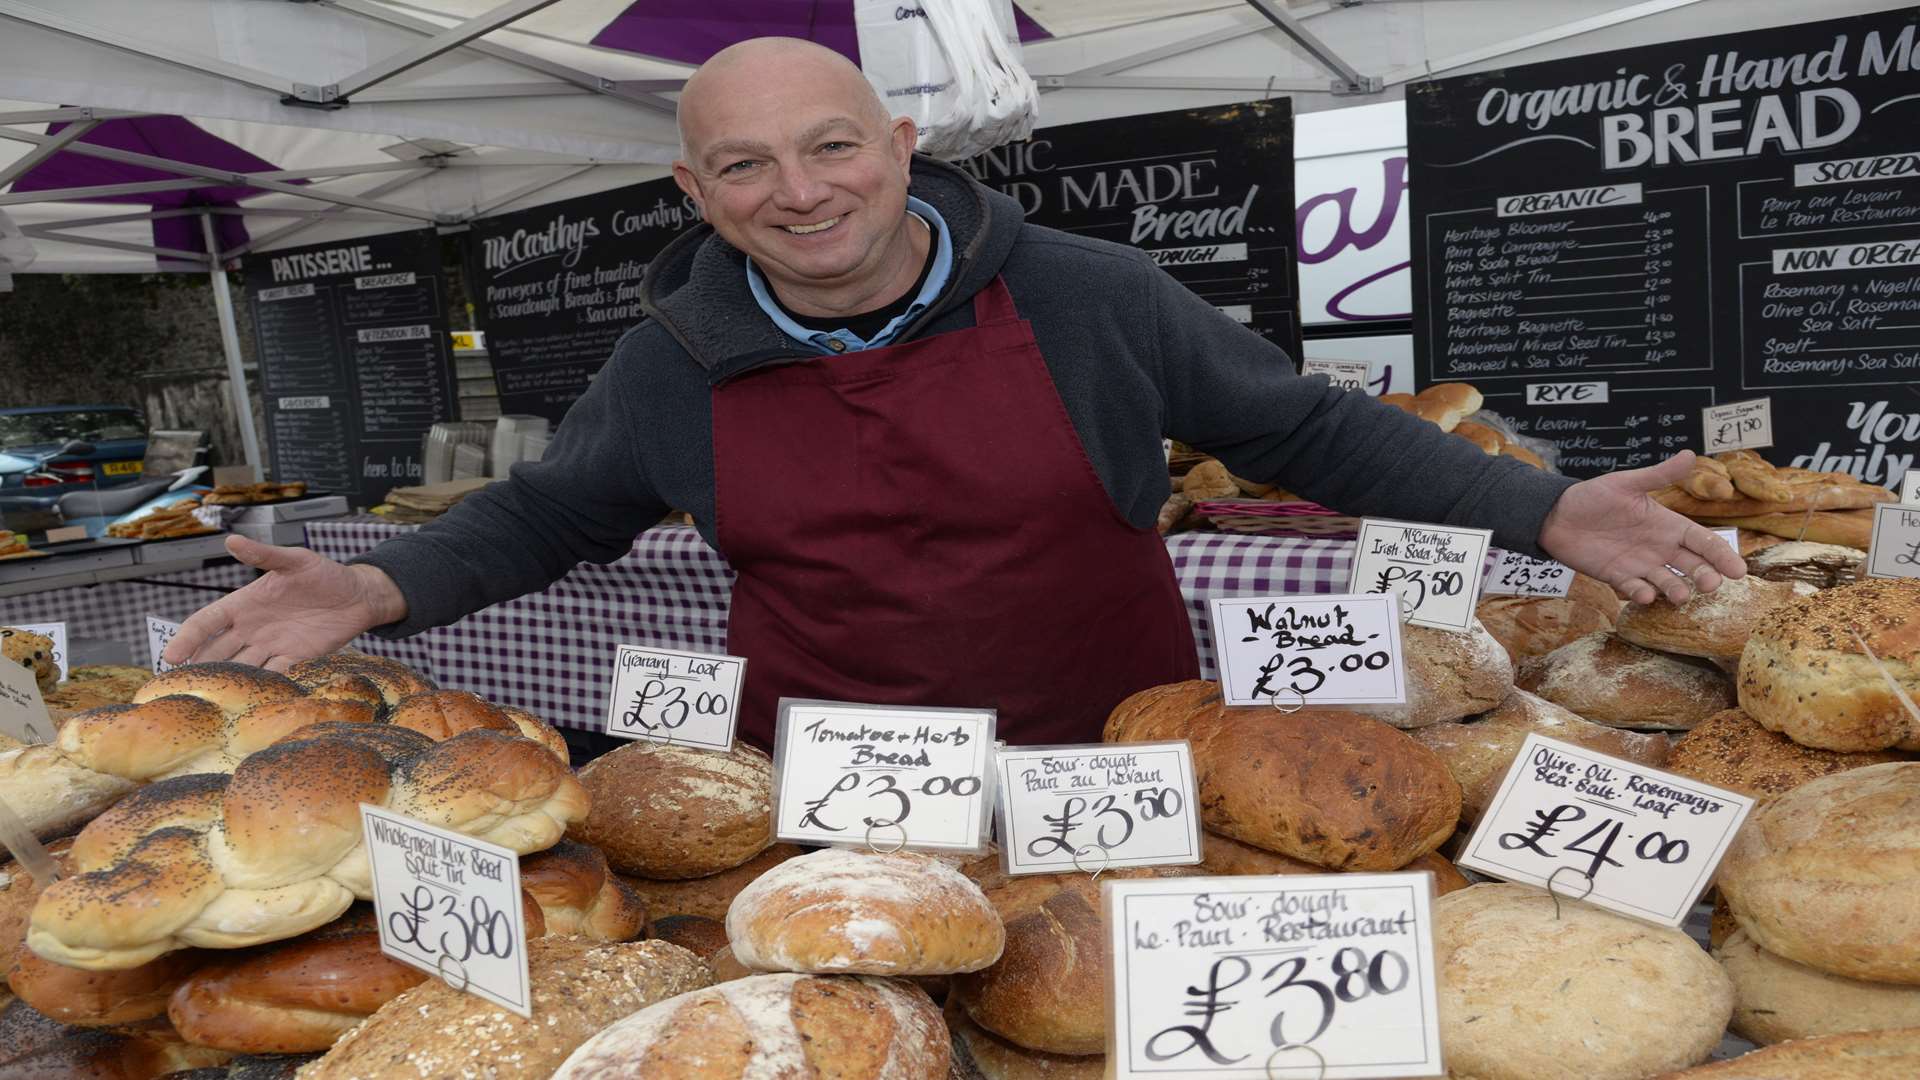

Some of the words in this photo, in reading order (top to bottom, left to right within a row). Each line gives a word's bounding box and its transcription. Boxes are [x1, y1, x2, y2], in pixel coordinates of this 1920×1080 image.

[1476, 68, 1652, 130] Organic
[1655, 63, 1688, 105] &
[1697, 36, 1847, 97] Hand
[1602, 86, 1861, 170] BREAD
[1060, 159, 1219, 212] MADE
[1504, 187, 1628, 214] ORGANIC
[1762, 197, 1801, 213] Pain
[1808, 194, 1837, 209] au
[1843, 188, 1902, 205] Levain
[612, 198, 683, 236] Country
[1760, 215, 1778, 229] Le
[1785, 212, 1826, 227] Pain
[1444, 224, 1501, 244] Heritage
[1507, 220, 1575, 237] Bloomer
[1444, 245, 1473, 260] Pain
[1477, 243, 1495, 257] de
[1502, 238, 1579, 257] Campagne
[1782, 248, 1839, 271] NON
[1444, 260, 1473, 274] Irish
[1479, 257, 1509, 271] Soda
[1516, 254, 1559, 267] Bread
[546, 272, 562, 298] of
[563, 272, 592, 293] fine
[1445, 276, 1482, 289] White
[1488, 270, 1523, 288] Split
[1527, 267, 1552, 284] Tin
[1763, 282, 1844, 299] Rosemary
[496, 297, 560, 318] Sourdough
[565, 288, 605, 308] Breads
[1447, 305, 1516, 323] Baguette
[1762, 303, 1804, 319] Olive
[1447, 323, 1511, 340] Heritage
[1517, 318, 1585, 336] Baguette
[1800, 317, 1833, 333] Sea
[1841, 315, 1883, 330] Salt
[1447, 341, 1517, 358] Wholemeal
[1522, 337, 1568, 353] Mixed
[1570, 335, 1600, 350] Seed
[1603, 334, 1627, 348] Tin
[1763, 337, 1817, 356] Spelt
[1447, 358, 1507, 373] Seaweed
[1526, 355, 1550, 368] Sea
[1556, 353, 1589, 367] Salt
[1763, 357, 1846, 377] Rosemary
[1855, 352, 1888, 370] Sea
[1534, 384, 1598, 402] RYE
[1535, 415, 1587, 431] Levain
[363, 456, 388, 478] here
[391, 456, 404, 478] to
[1371, 538, 1399, 556] Irish
[1405, 543, 1431, 560] Soda
[1433, 546, 1467, 564] Bread
[1247, 603, 1349, 634] Walnut
[1271, 624, 1367, 649] Bread
[622, 651, 671, 680] Granary
[688, 658, 725, 681] Loaf
[1252, 651, 1390, 700] £3.00
[623, 680, 728, 730] £3.00
[804, 718, 894, 743] Tomatoe
[911, 726, 970, 746] Herb
[850, 744, 932, 767] Bread
[1089, 753, 1138, 773] dough
[1021, 769, 1060, 792] Pain
[1070, 775, 1096, 788] au
[1106, 768, 1163, 787] Levain
[1634, 795, 1683, 820] Loaf
[372, 820, 437, 860] Wholemeal
[470, 848, 502, 883] Seed
[1498, 804, 1689, 880] £4.00
[442, 860, 467, 886] Tin
[1270, 889, 1348, 922] dough
[1174, 919, 1236, 949] Pain
[1258, 910, 1417, 942] Restaurant
